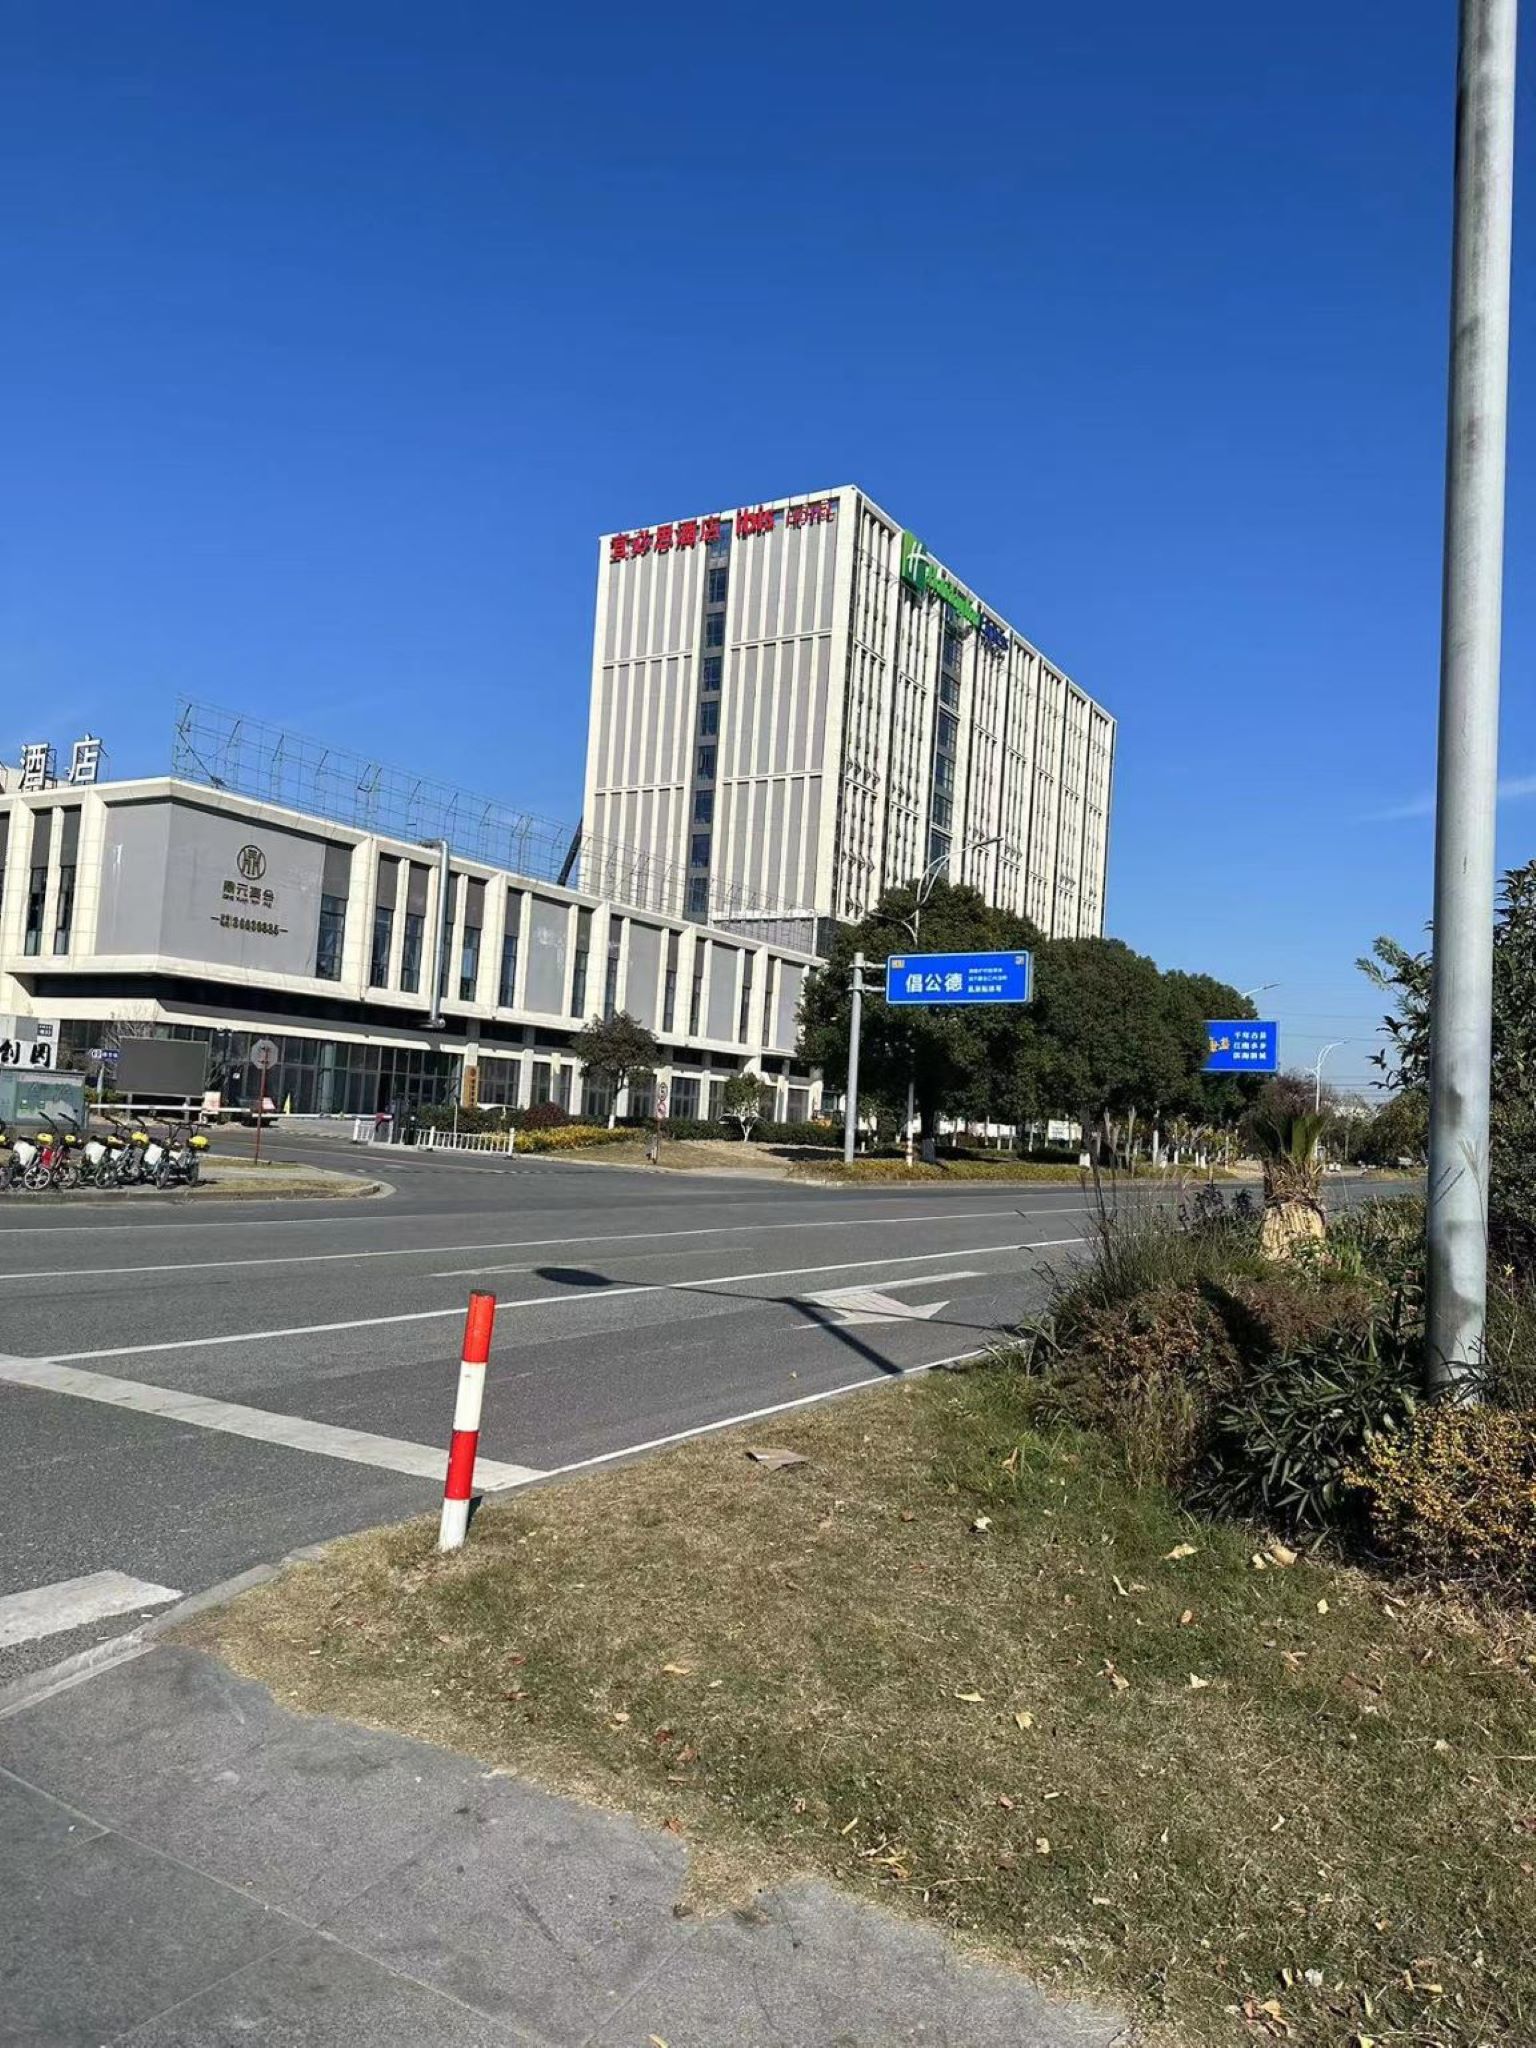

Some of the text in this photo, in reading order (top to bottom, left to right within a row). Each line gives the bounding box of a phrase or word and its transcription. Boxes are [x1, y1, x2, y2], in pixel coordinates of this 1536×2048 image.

[610, 516, 722, 561] 宜必思酒店
[18, 733, 102, 790] 酒店
[905, 972, 964, 994] 倡公德
